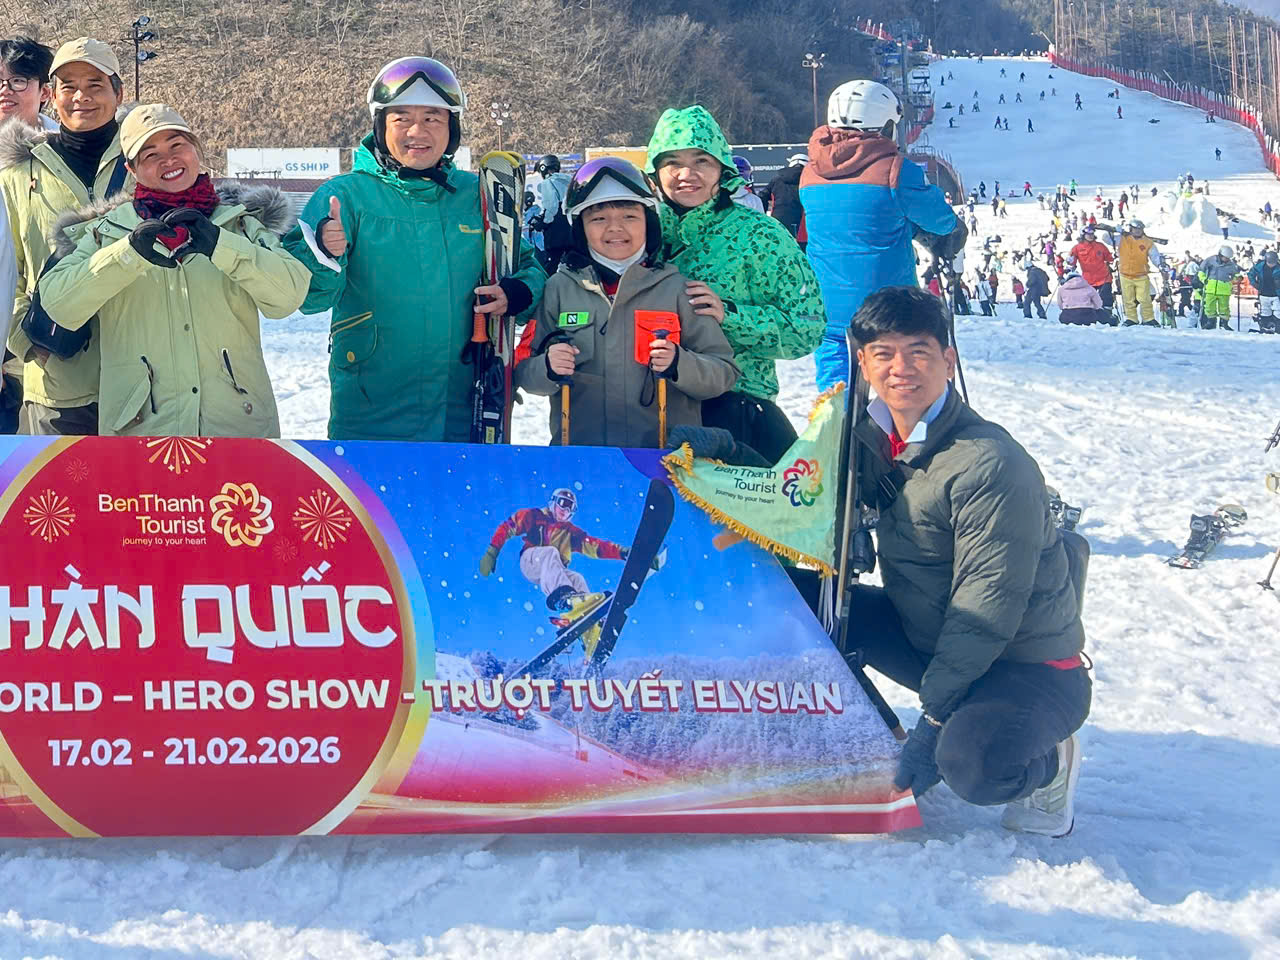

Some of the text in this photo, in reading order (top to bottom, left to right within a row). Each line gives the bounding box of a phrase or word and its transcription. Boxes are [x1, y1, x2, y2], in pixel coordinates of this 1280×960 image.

[285, 163, 298, 172] GS
[496, 184, 504, 213] elan
[734, 477, 776, 494] Tourist
[744, 495, 758, 504] your
[136, 515, 206, 535] Tourist
[122, 536, 207, 547] journey to your heart
[182, 561, 397, 664] QUỐC
[145, 679, 255, 711] HERO
[267, 678, 390, 710] SHOW
[422, 674, 556, 719] TRƯỢT
[563, 670, 682, 711] TUYẾT
[694, 680, 842, 713] ELYSIAN
[48, 738, 132, 766] 17.02
[164, 736, 341, 766] 21.02.2026
